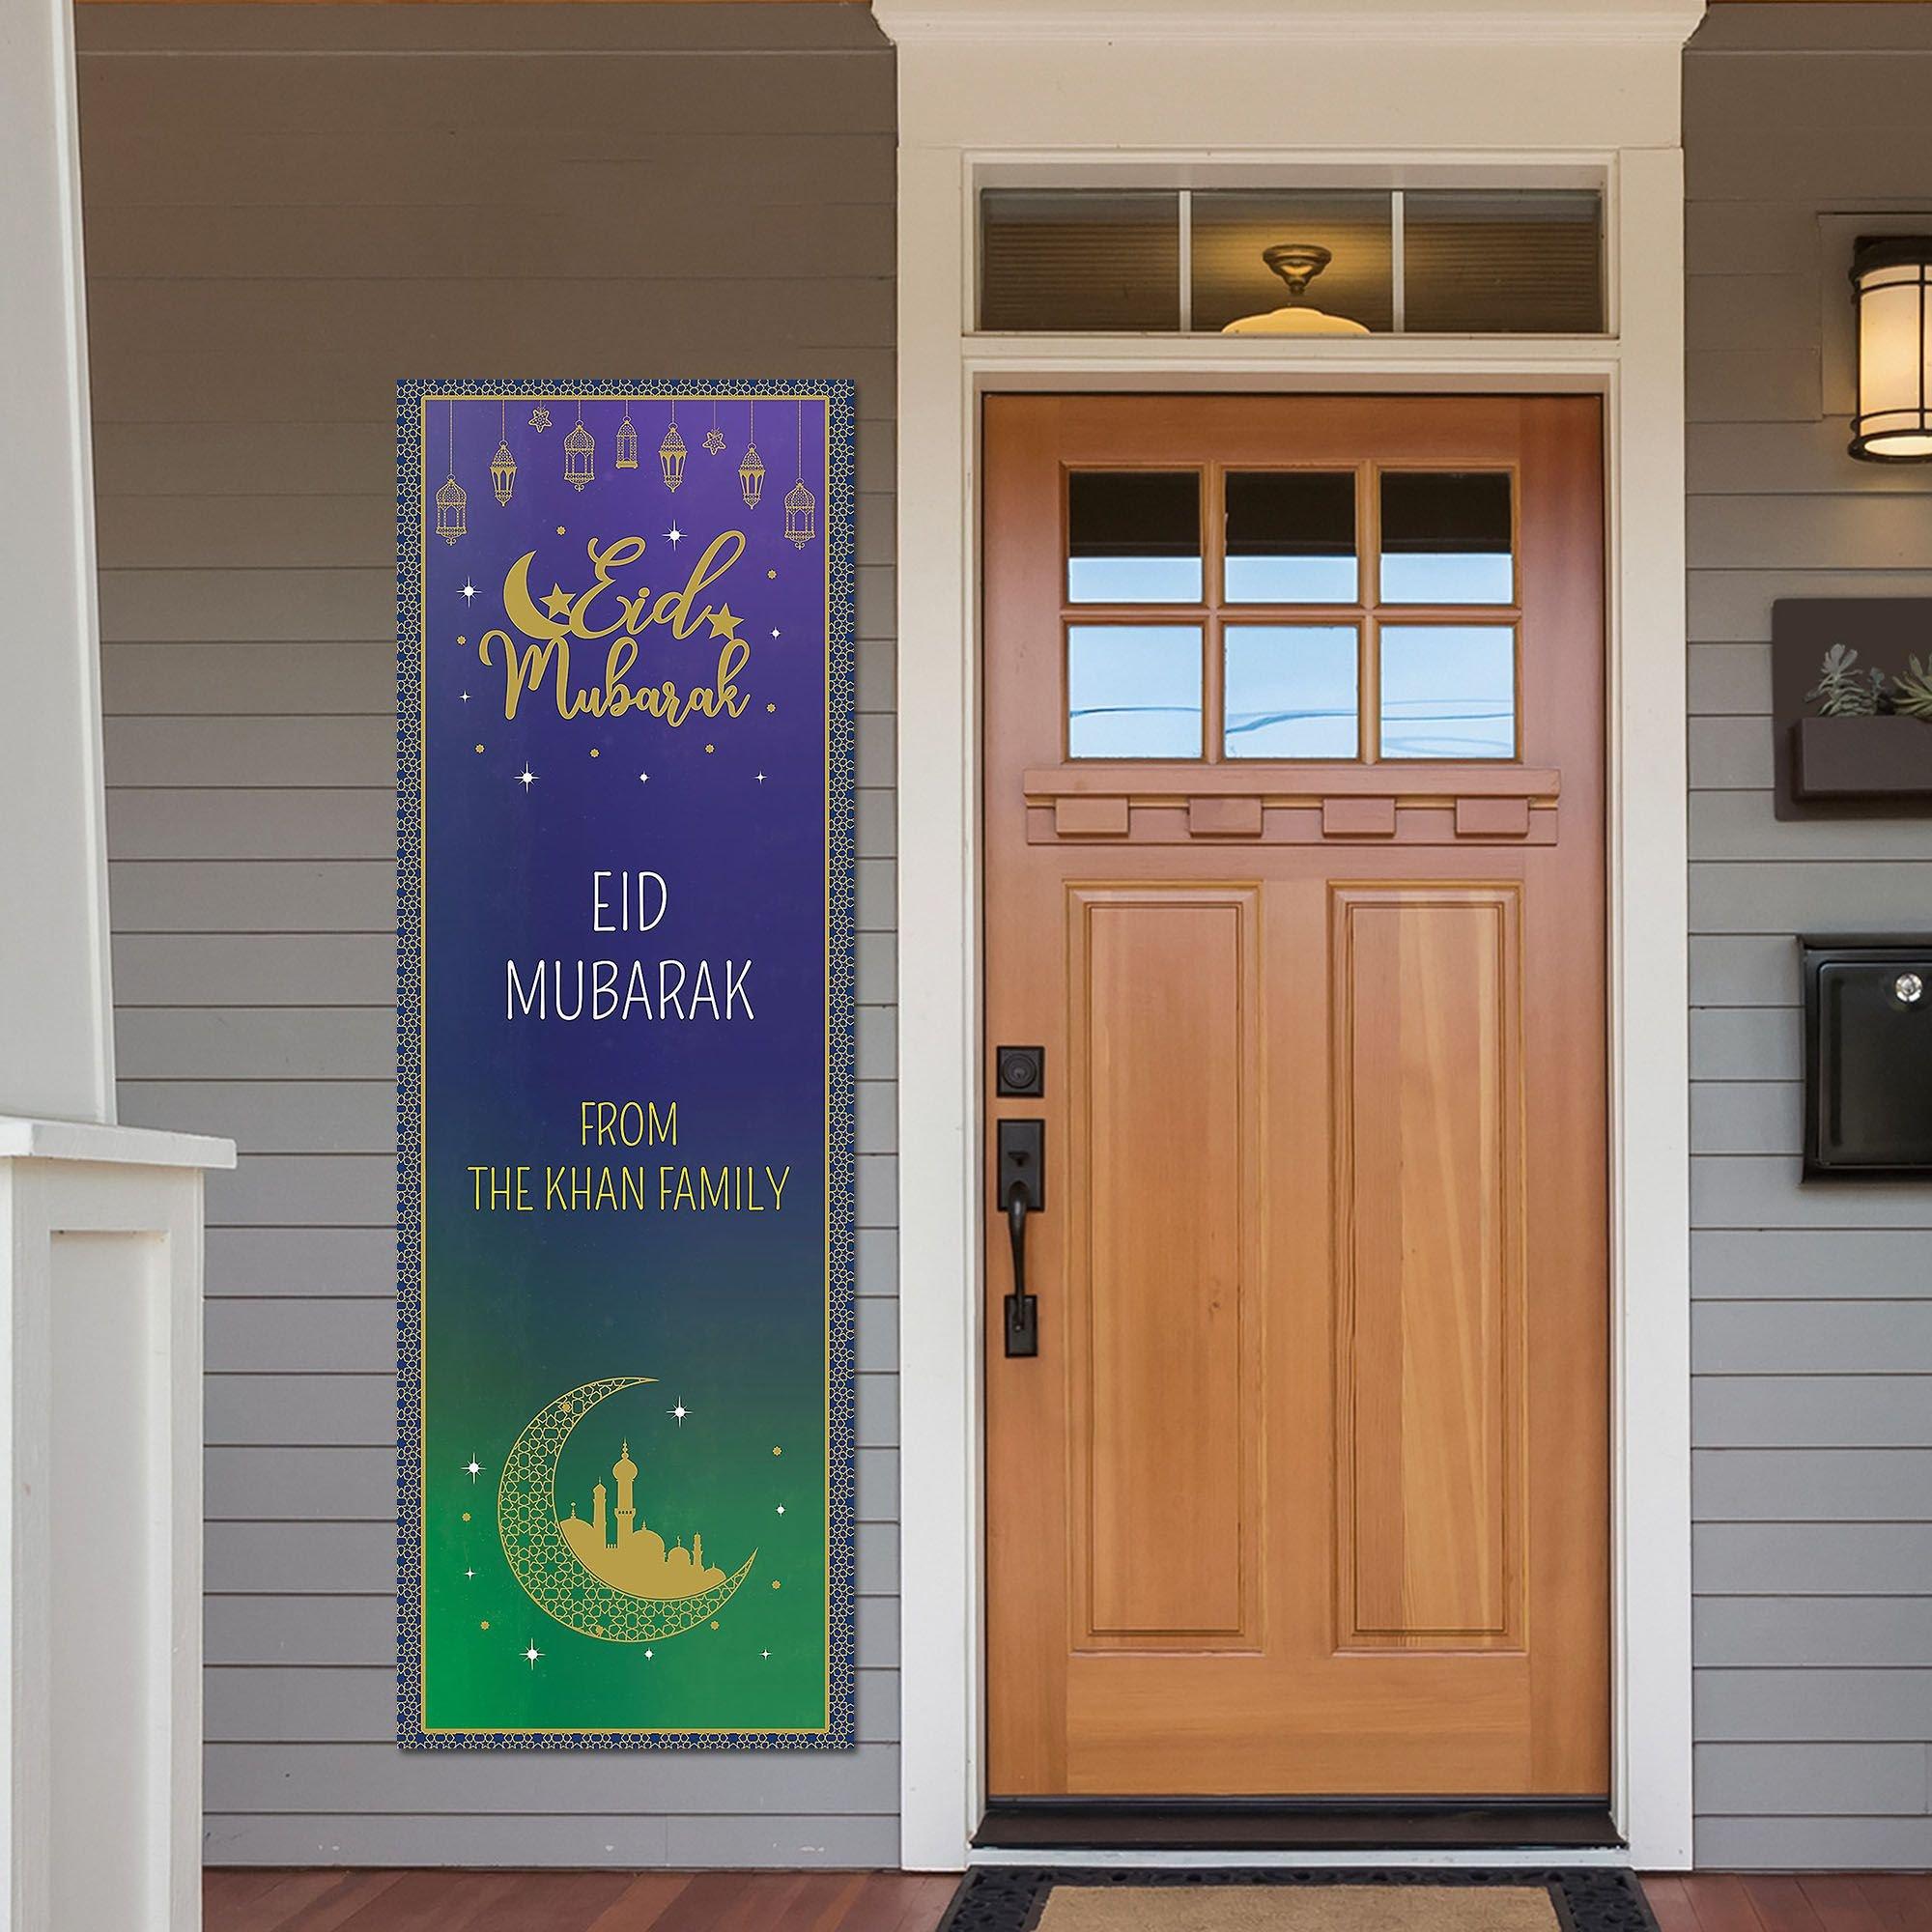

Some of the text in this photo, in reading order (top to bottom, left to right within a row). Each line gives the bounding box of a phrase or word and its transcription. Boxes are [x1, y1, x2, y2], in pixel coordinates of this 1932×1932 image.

[570, 529, 747, 639] Eid
[478, 629, 752, 727] Mubarak
[593, 870, 668, 932] EID
[505, 959, 754, 1021] MUBARAK
[581, 1101, 678, 1147] FROM
[467, 1165, 790, 1211] THE KHAN FAMILY
